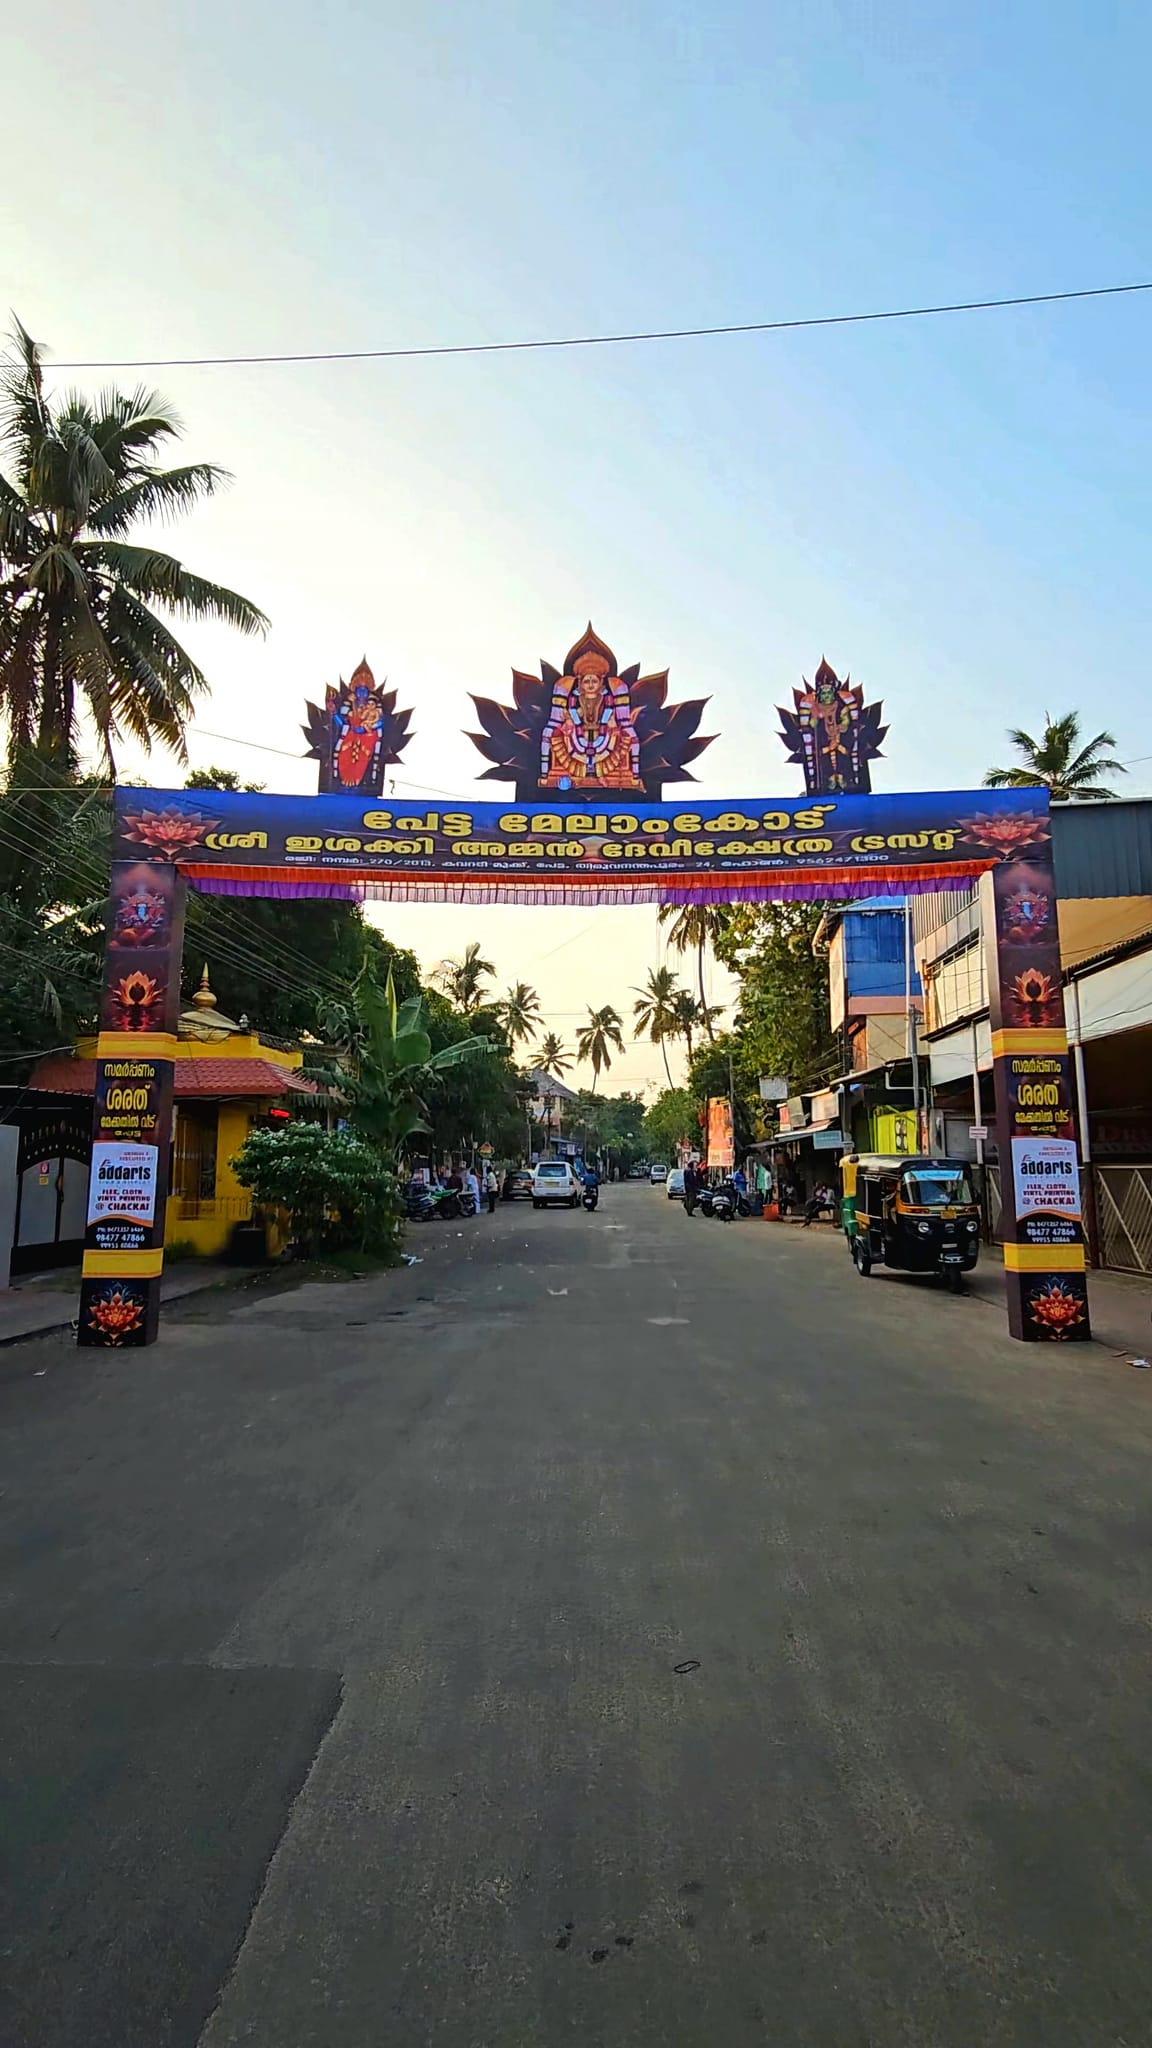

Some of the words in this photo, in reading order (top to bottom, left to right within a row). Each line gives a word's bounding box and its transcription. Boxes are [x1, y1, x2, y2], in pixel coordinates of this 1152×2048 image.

[362, 809, 473, 837] പേട്ട
[499, 804, 837, 835] മേലാംകോട്
[205, 831, 268, 850] ശ്രീ
[286, 836, 434, 855] ഇശക്കി
[451, 841, 585, 857] അമ്മൻ
[104, 1061, 156, 1077] സമർപ്പണം
[1012, 1058, 1062, 1073] സമർപ്പണം
[106, 1084, 151, 1110] ശരത്
[1017, 1080, 1060, 1105] ശരത്
[98, 1165, 151, 1180] addarts
[1020, 1160, 1073, 1175] addarts
[107, 1202, 150, 1211] CHACKAI
[1034, 1197, 1076, 1206] CHACKAI
